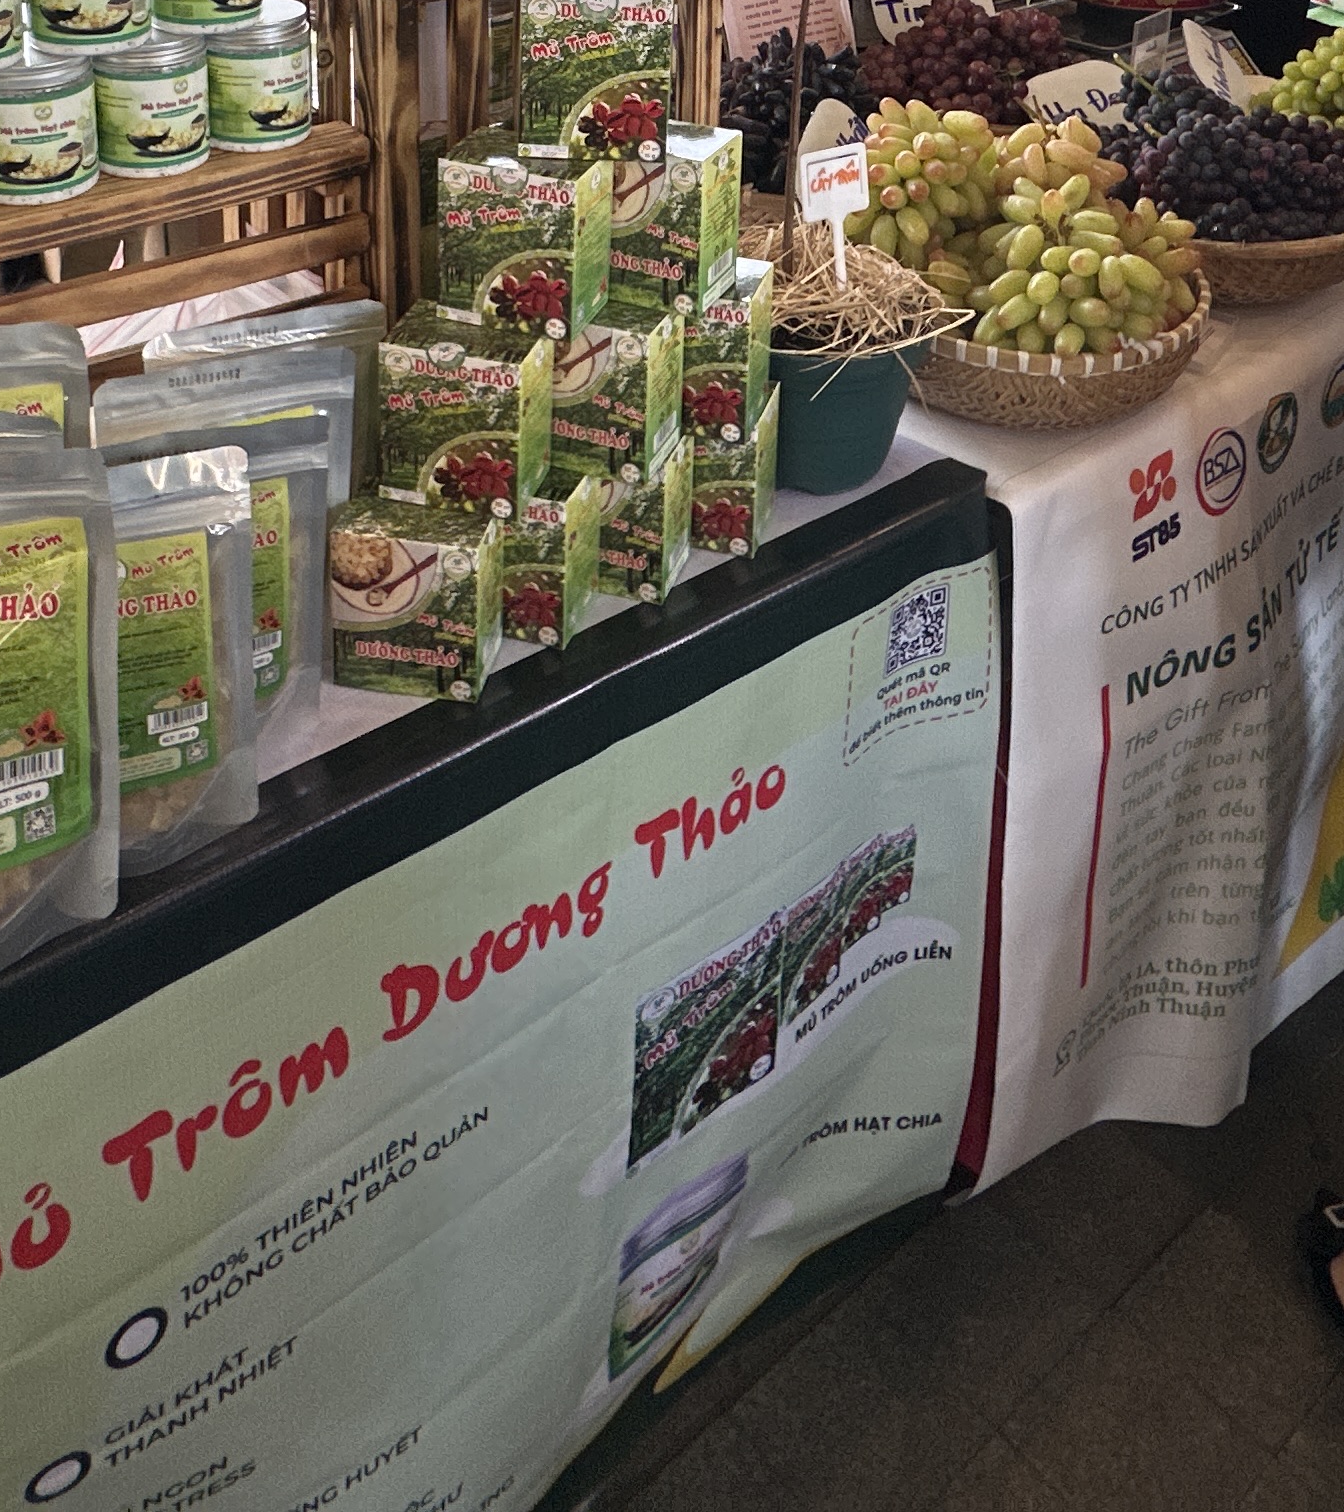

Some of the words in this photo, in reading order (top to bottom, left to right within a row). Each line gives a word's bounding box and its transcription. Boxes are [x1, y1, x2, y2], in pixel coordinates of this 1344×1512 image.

[565, 31, 615, 52] Trôm
[5, 533, 64, 559] Trôm
[1131, 512, 1182, 563] ST85
[1102, 595, 1163, 635] CÔNG
[1170, 579, 1192, 608] TY
[1194, 549, 1238, 595] TNHH
[929, 661, 951, 677] QR
[1126, 633, 1237, 706] NÔNG
[1245, 584, 1283, 653] SẢN
[102, 1026, 352, 1205] Trôm
[381, 862, 615, 1045] Dương
[635, 763, 787, 880] Thảo
[860, 950, 909, 984] UỐNG
[914, 939, 953, 961] LIỀN
[854, 1115, 891, 1136] HẠT
[896, 1113, 943, 1131] CHIA
[180, 1247, 249, 1302] 100%
[255, 1188, 334, 1252] THIÊN
[341, 1130, 418, 1195] NHIÊN
[184, 1249, 284, 1329] KHÔNG
[291, 1195, 360, 1254] CHẤT
[364, 1159, 418, 1205] BẢO
[422, 1106, 489, 1163] QUẢN
[104, 1402, 165, 1446] GIẢI
[173, 1346, 250, 1407] KHÁT
[104, 1398, 209, 1468] THANH
[217, 1335, 298, 1405] NHIỆT
[142, 1456, 228, 1510] NGON
